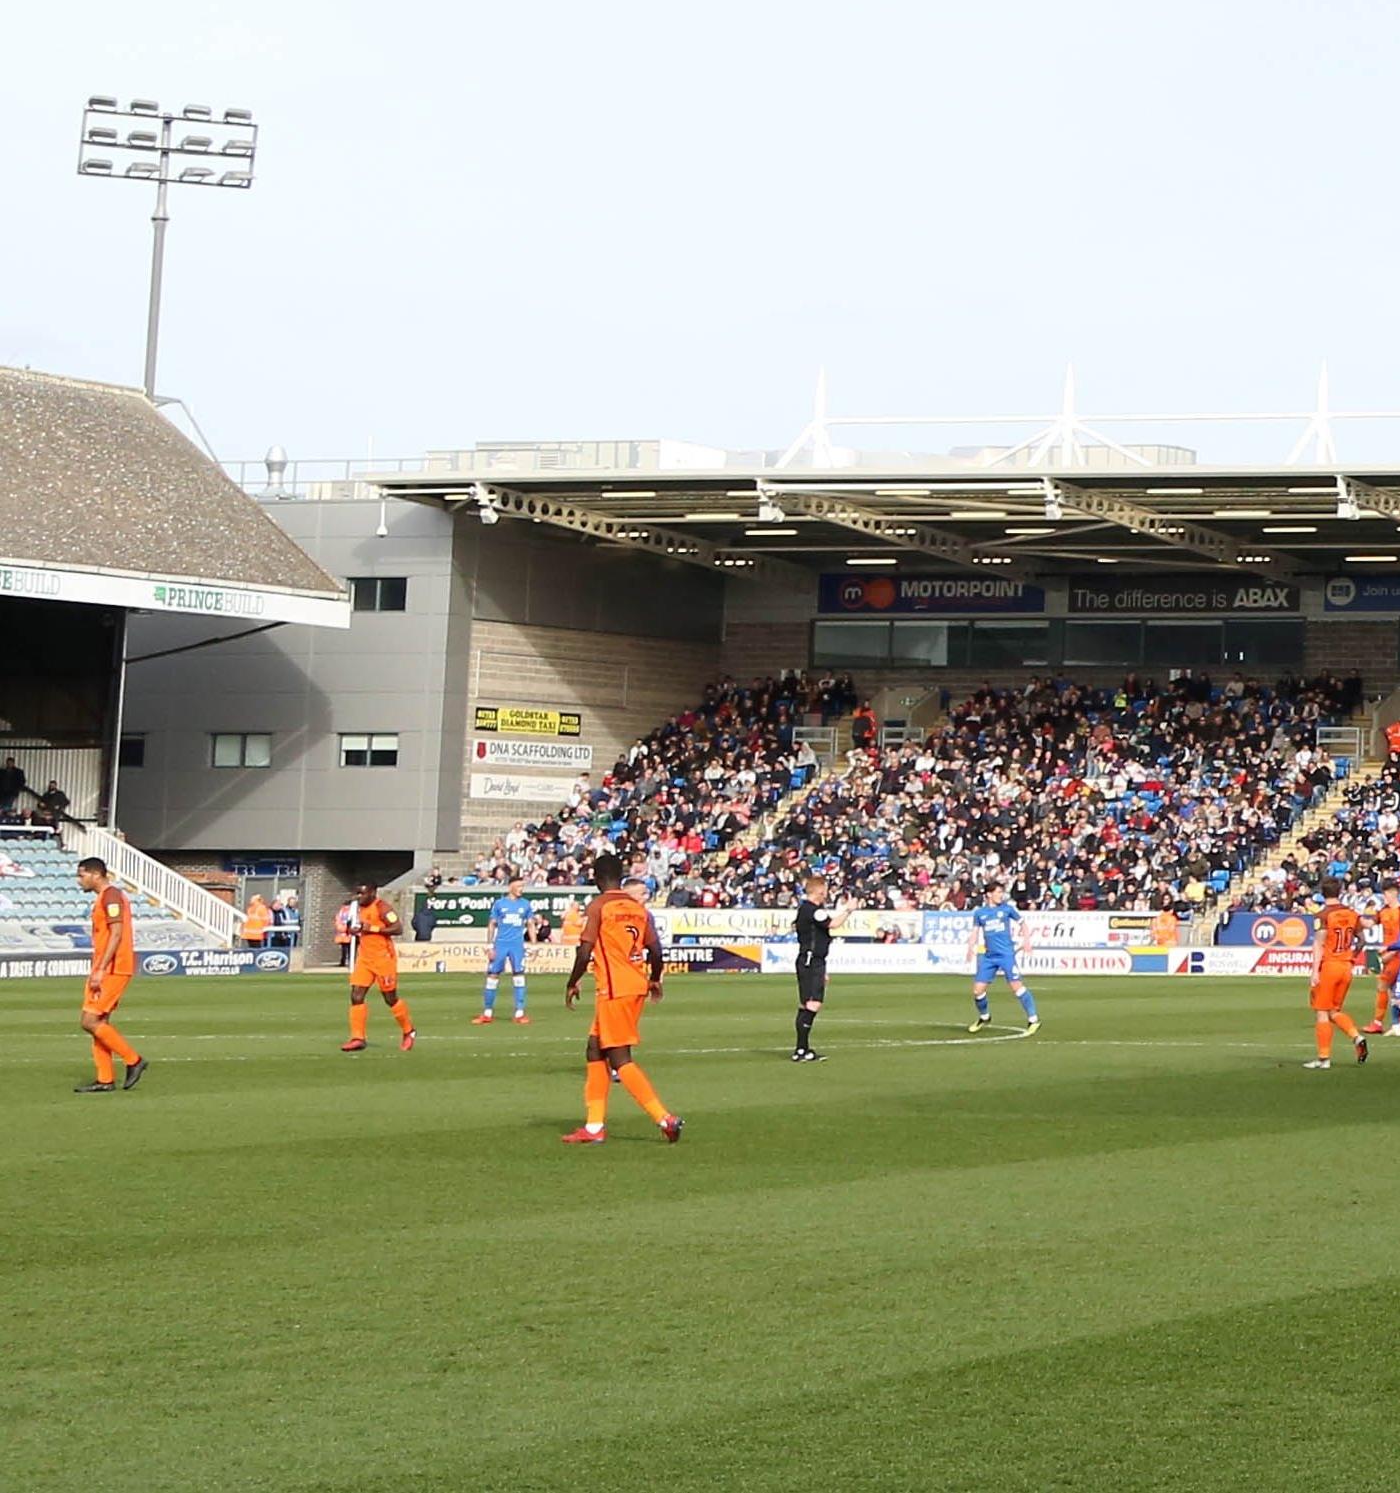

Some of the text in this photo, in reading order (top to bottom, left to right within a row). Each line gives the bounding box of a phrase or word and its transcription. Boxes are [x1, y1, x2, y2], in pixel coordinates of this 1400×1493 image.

[901, 580, 1024, 598] MOTORPOINT
[167, 587, 265, 616] PRINCEBUILD
[1073, 588, 1289, 609] The difference is ABAX
[489, 742, 590, 759] DNA SCAFFOLDING LTD
[680, 912, 718, 928] ABC
[203, 951, 254, 966] Harrison
[661, 948, 714, 962] CENTRE
[1268, 952, 1314, 963] INSURA
[0, 960, 8, 978] A
[9, 959, 34, 978] TASTE
[34, 959, 48, 977] OF
